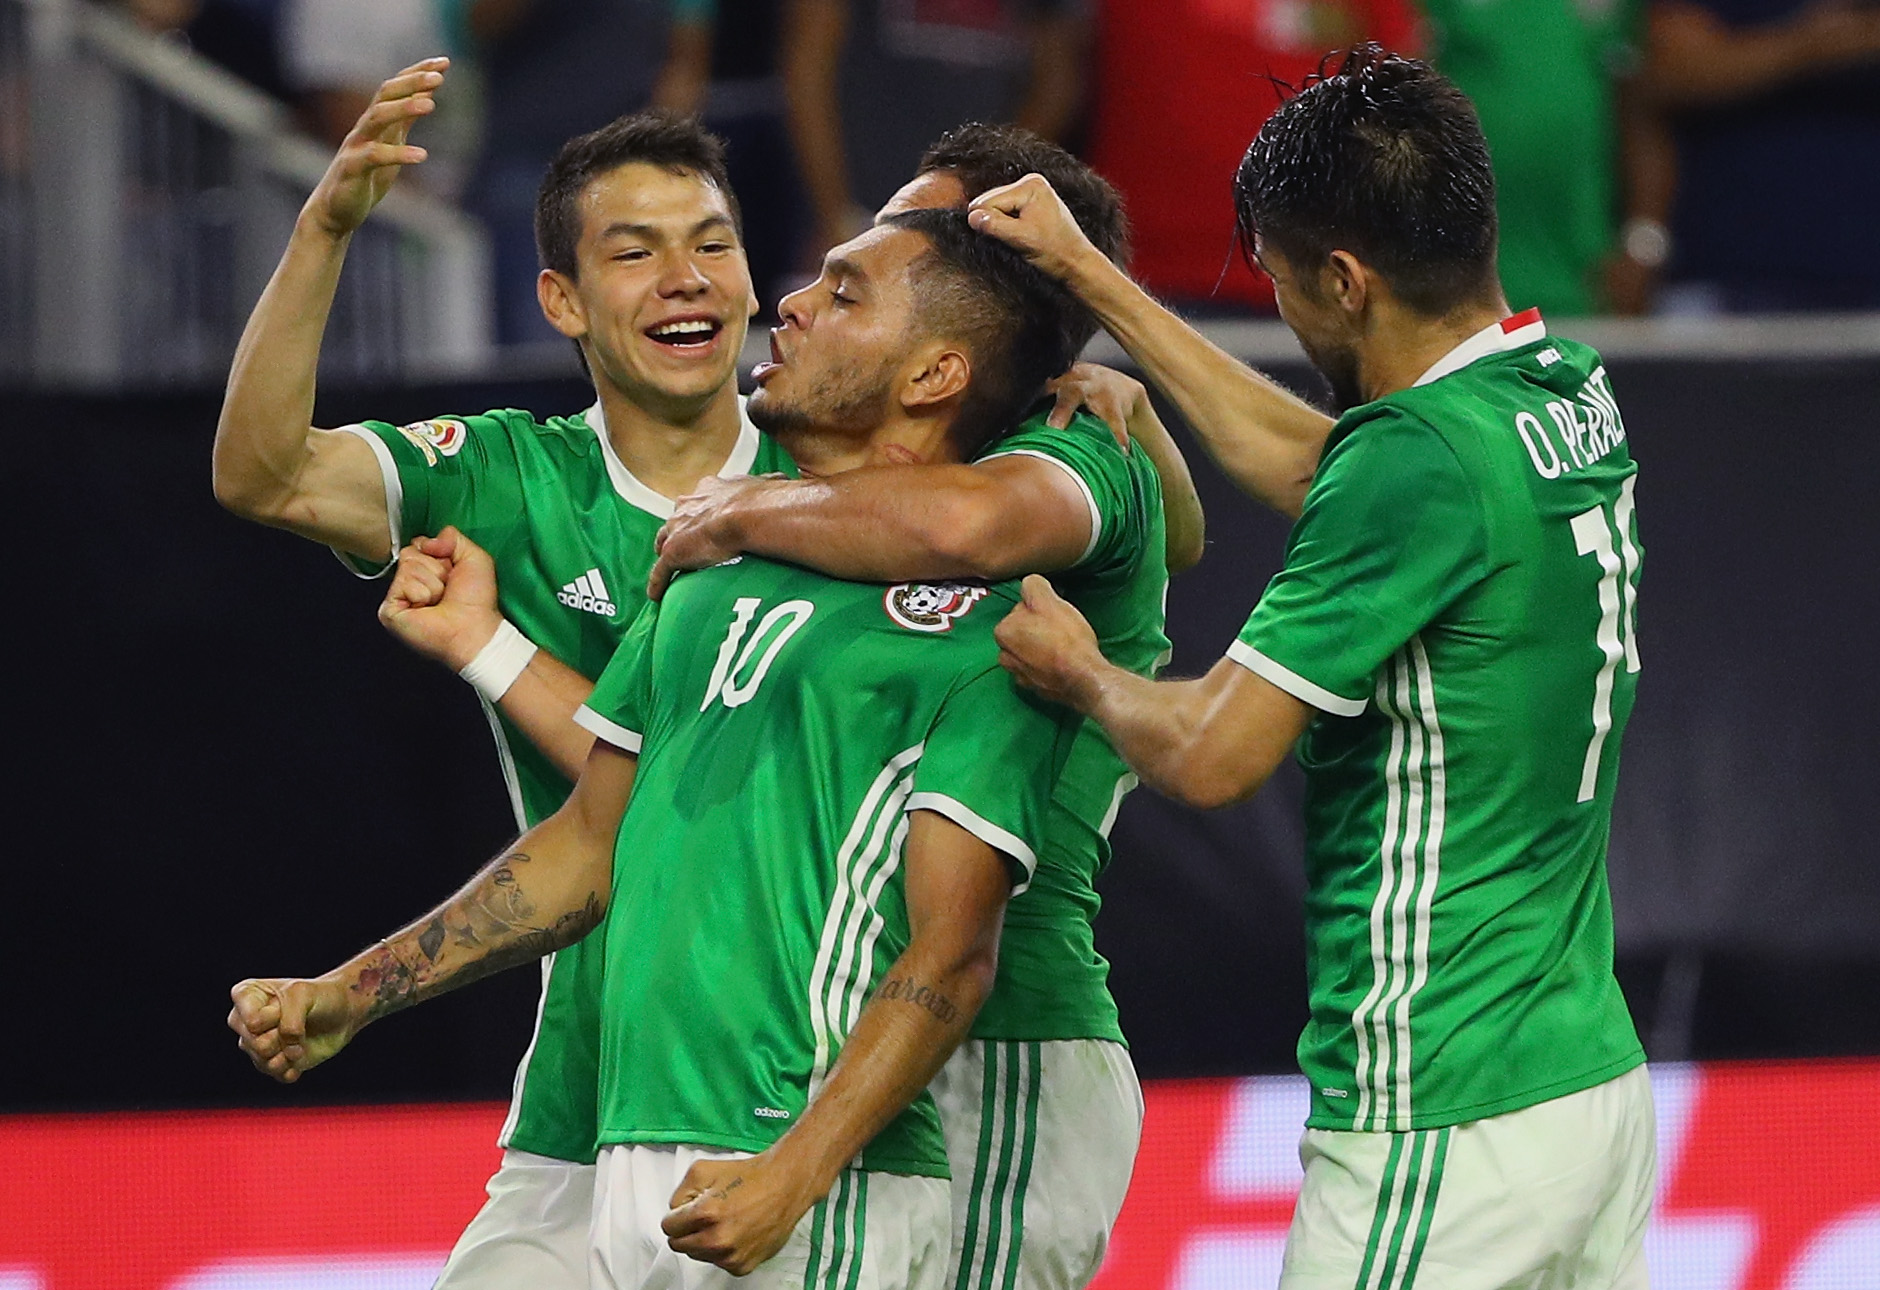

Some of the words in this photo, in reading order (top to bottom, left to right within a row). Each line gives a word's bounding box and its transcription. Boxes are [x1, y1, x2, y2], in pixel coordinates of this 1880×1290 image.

[557, 591, 617, 617] adidas
[700, 597, 815, 712] 10
[754, 1106, 790, 1119] adizero
